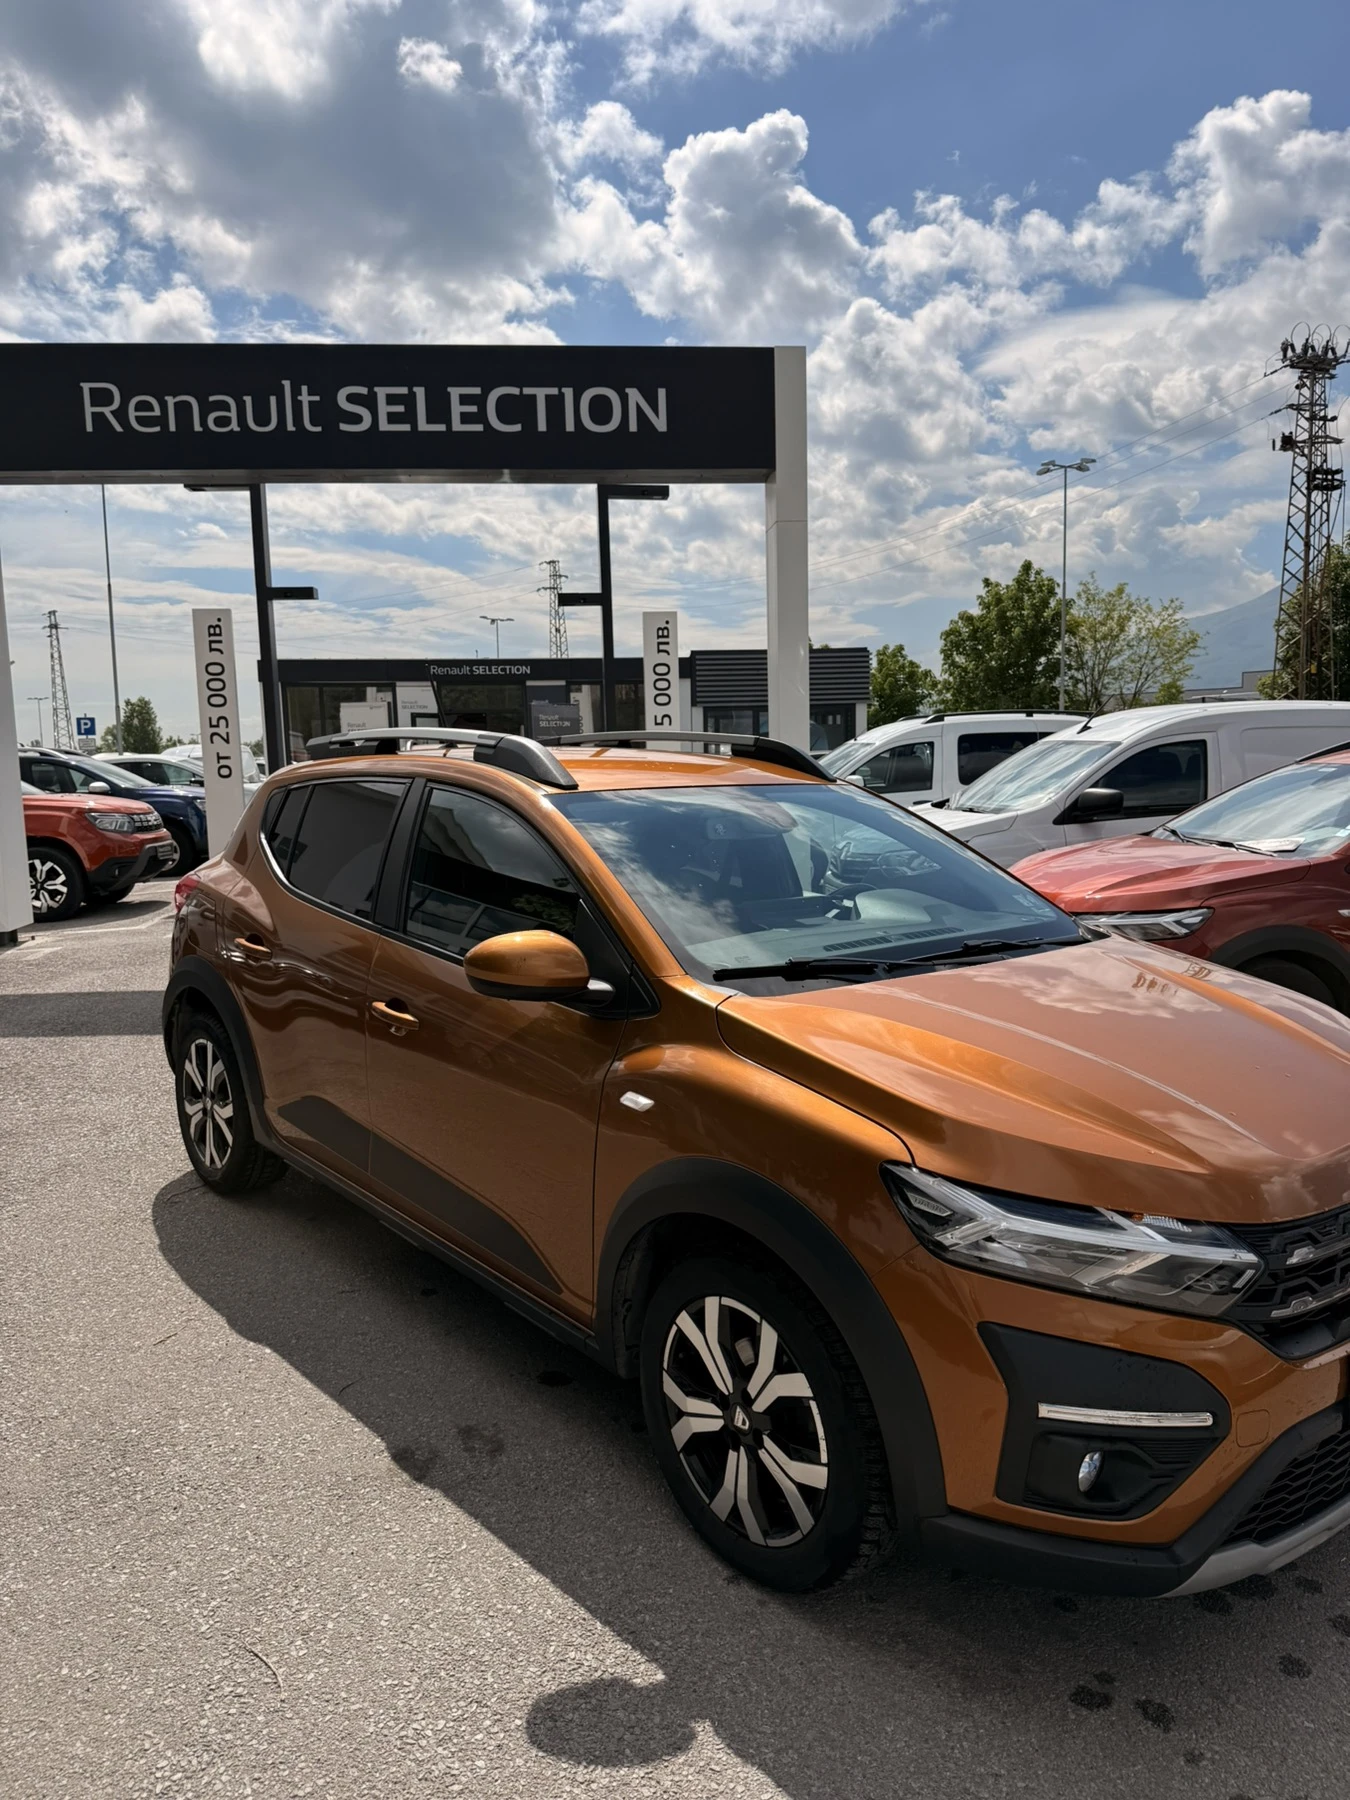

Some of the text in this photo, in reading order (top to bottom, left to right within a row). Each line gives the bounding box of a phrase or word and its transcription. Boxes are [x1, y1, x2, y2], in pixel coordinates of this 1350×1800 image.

[79, 379, 669, 434] Renault SELECTION
[430, 664, 531, 675] Renault SELECTION
[652, 619, 672, 726] 5 000 лв.
[204, 617, 233, 779] от 25 000 лв.
[80, 719, 92, 734] P
